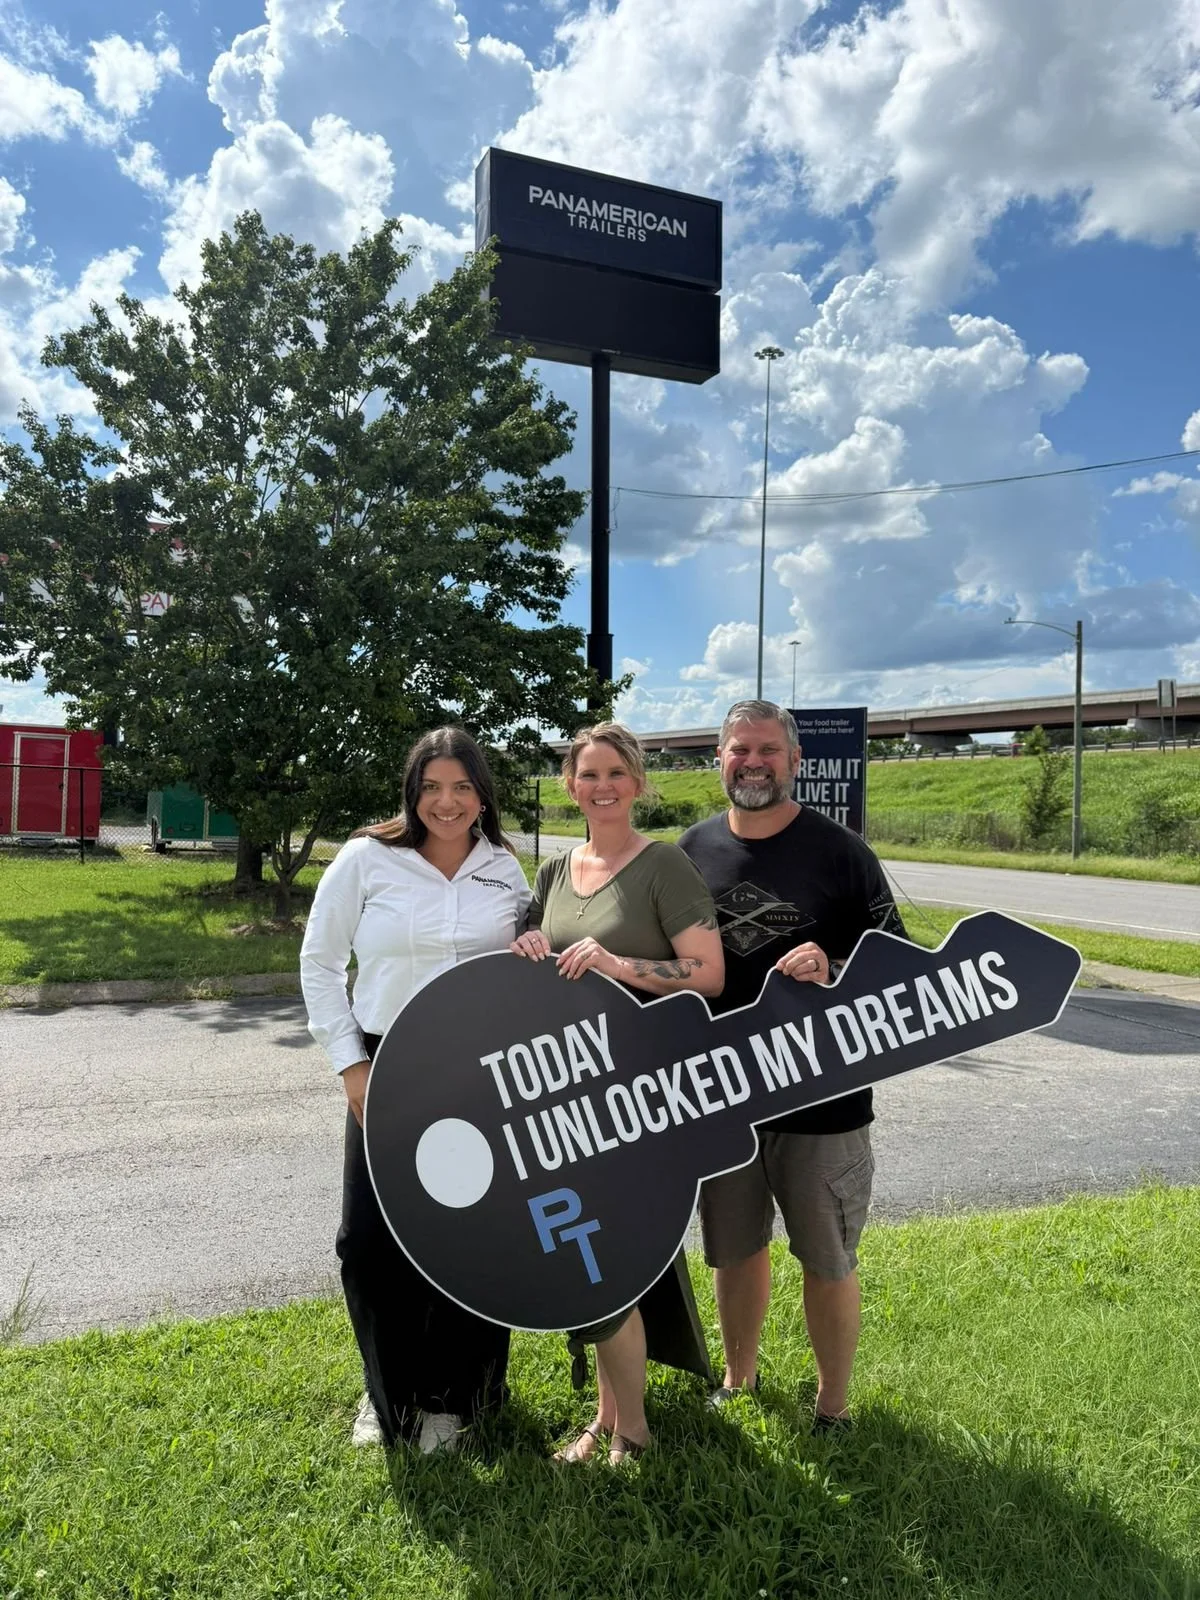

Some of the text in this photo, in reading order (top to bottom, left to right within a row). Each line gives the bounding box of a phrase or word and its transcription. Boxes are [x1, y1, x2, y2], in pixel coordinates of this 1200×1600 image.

[528, 185, 688, 238] PANAMERICAN
[567, 213, 647, 243] TRAILERS
[798, 719, 813, 727] Your
[838, 726, 855, 734] here!
[797, 758, 862, 779] REAM IT
[796, 782, 850, 803] LIVE IT
[835, 806, 850, 826] IT
[479, 1012, 616, 1109] TODAY
[502, 951, 1019, 1181] I UNLOCKED MY DREAMS
[527, 1187, 603, 1284] PT
